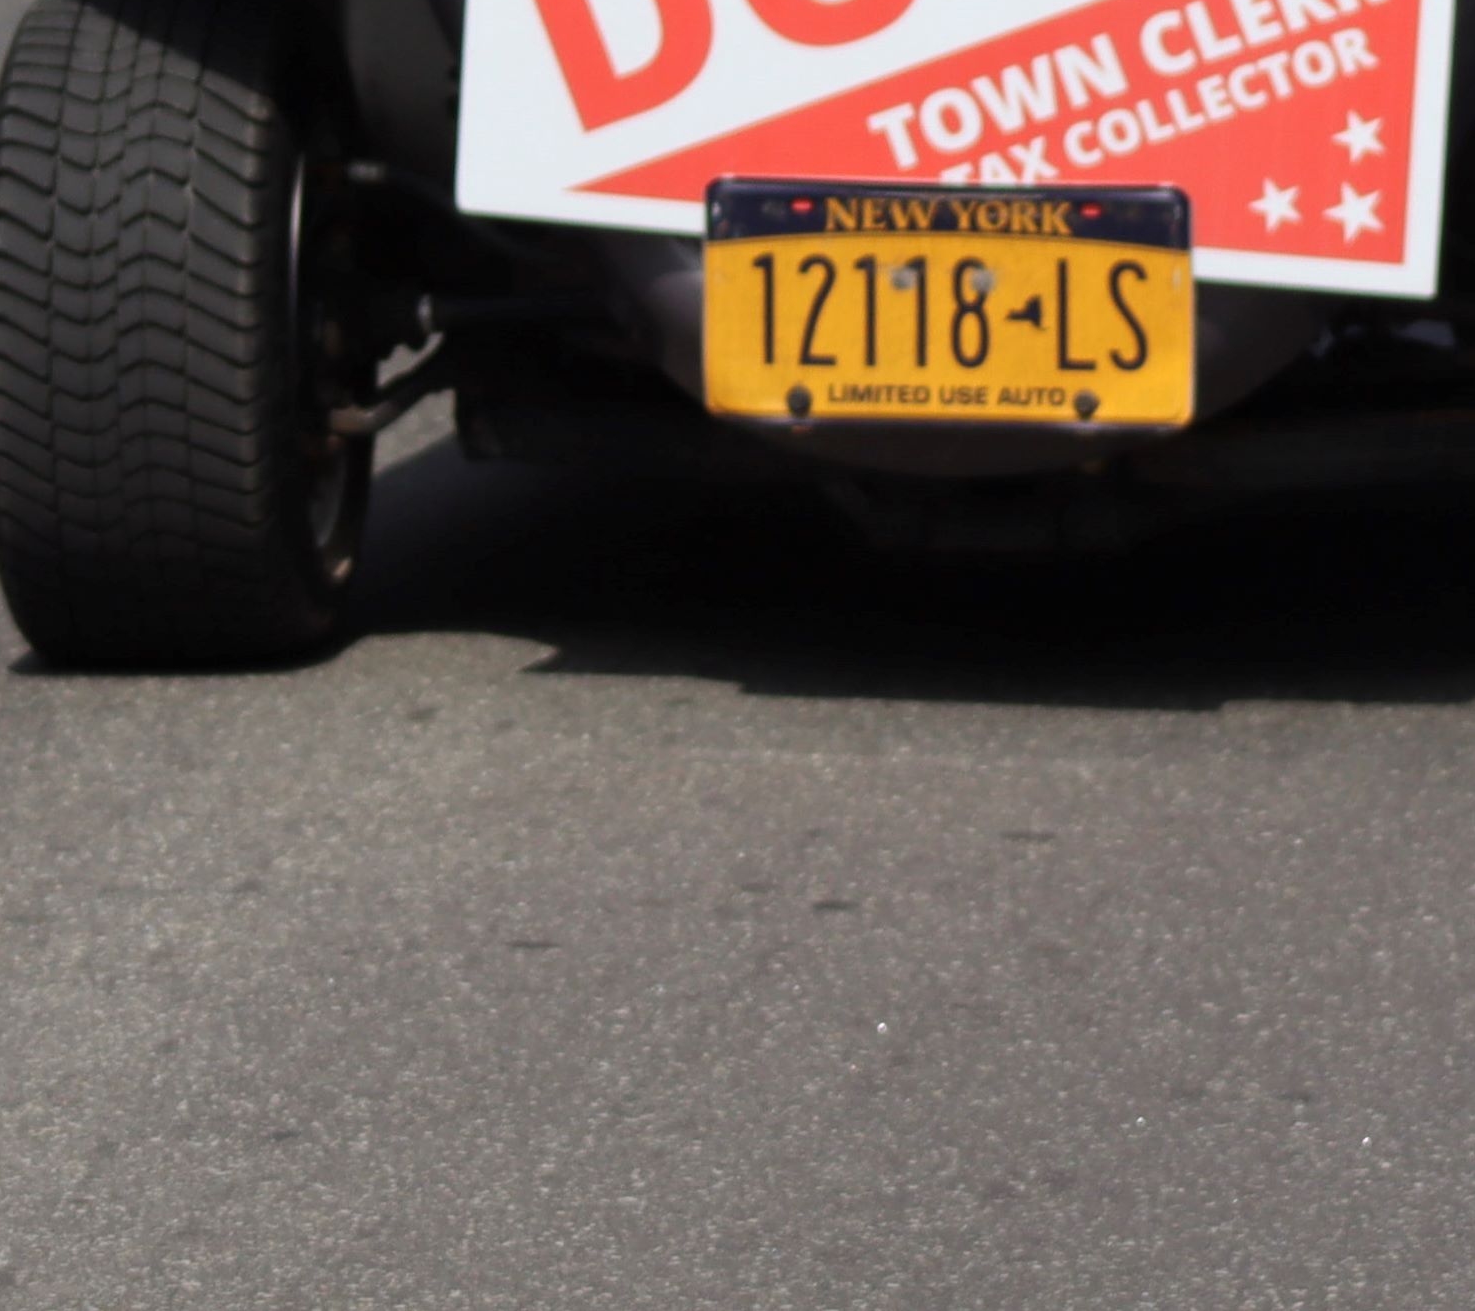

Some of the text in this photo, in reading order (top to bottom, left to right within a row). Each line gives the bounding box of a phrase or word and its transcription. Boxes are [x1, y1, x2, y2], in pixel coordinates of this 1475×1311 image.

[865, 32, 1129, 170] TOWN
[1062, 27, 1379, 169] COLLECTOR
[825, 196, 1073, 236] NEW YORK
[827, 382, 1067, 408] LIMITED USE AUTO
